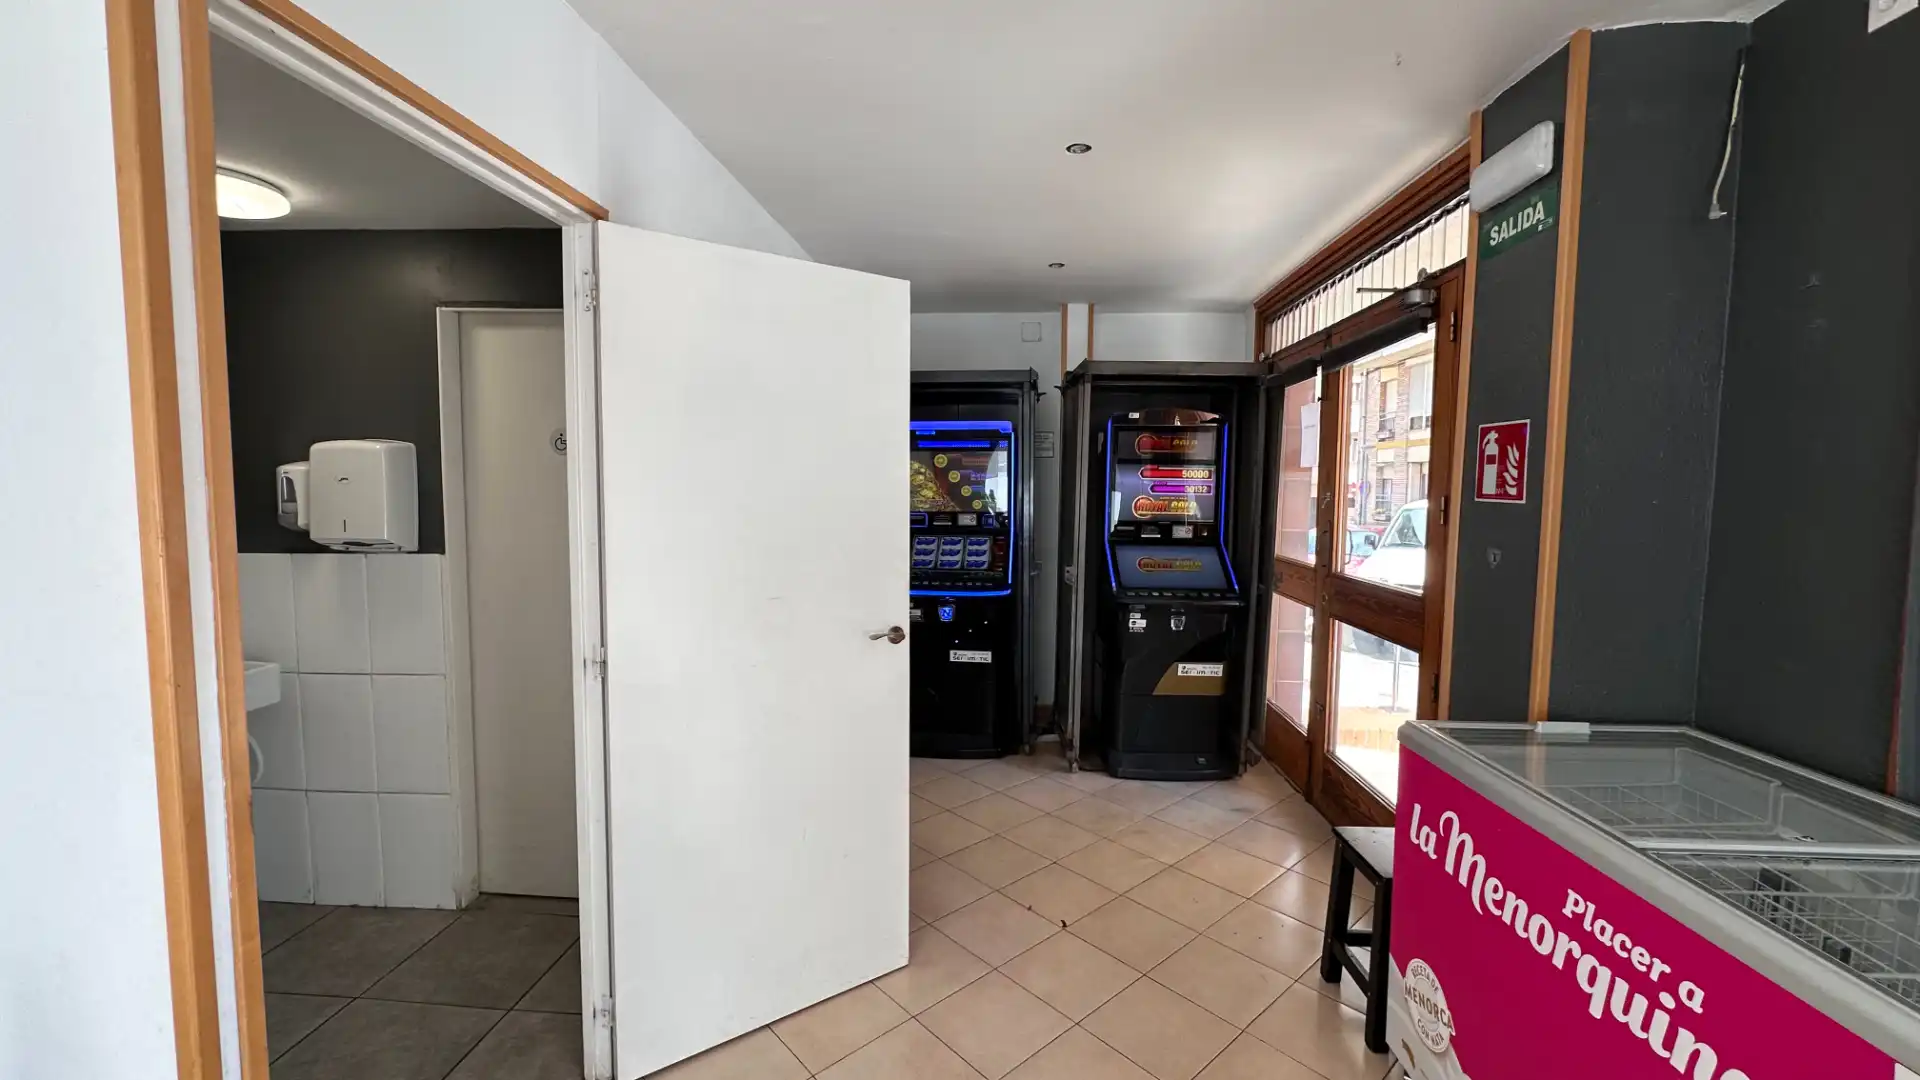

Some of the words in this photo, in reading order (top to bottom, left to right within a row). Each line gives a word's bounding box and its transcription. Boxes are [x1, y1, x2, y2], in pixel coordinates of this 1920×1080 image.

[1489, 200, 1545, 246] SALIDA
[1181, 469, 1209, 479] 50000
[1439, 810, 1752, 1080] Menorquin
[1562, 888, 1672, 983] Placer
[1678, 980, 1705, 1014] a
[1411, 965, 1430, 980] RECETA
[1404, 981, 1453, 1029] MENORCA
[1417, 1019, 1430, 1041] CON
